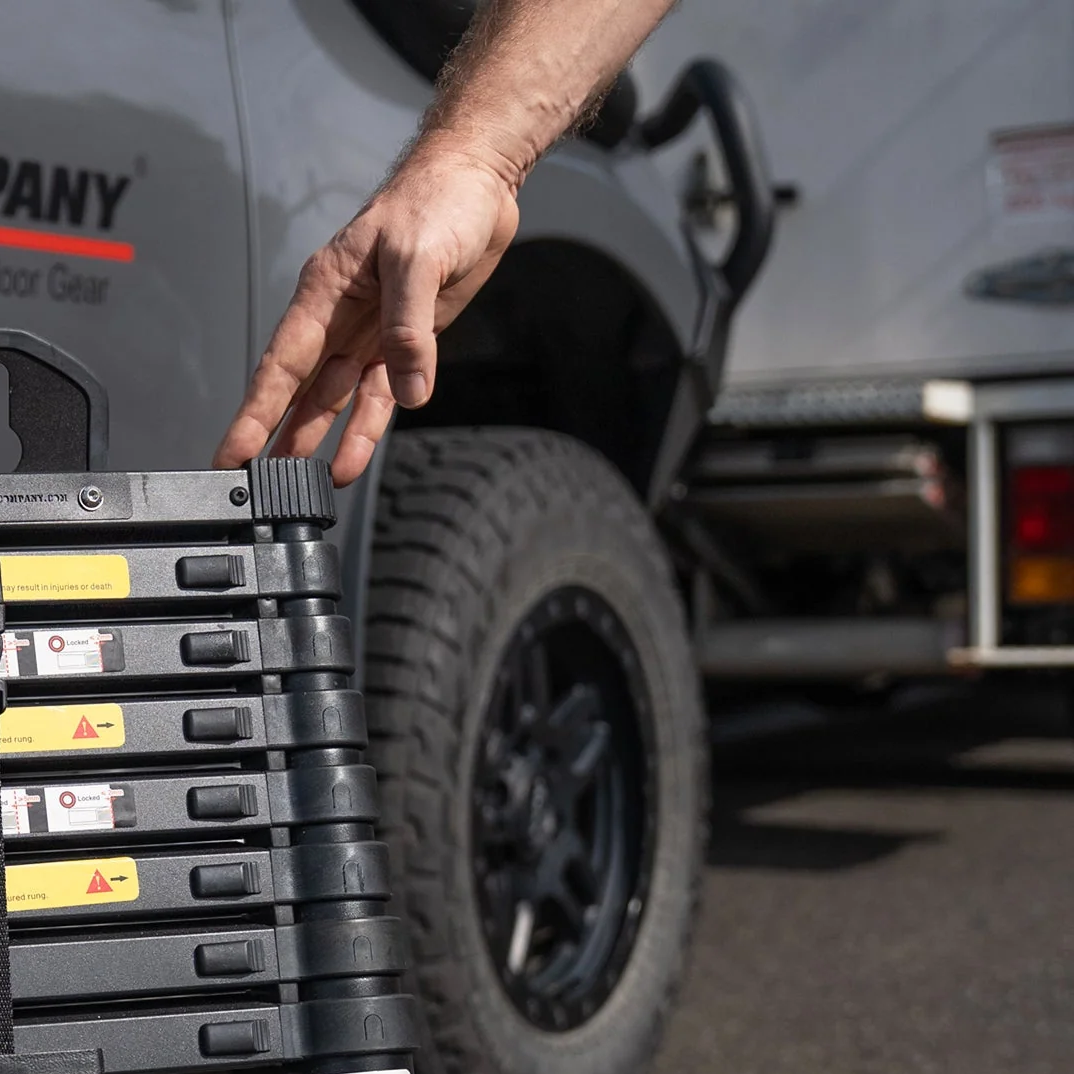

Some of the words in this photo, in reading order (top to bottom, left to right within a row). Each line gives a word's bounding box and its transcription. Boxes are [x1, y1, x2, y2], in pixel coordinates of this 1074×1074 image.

[47, 264, 110, 305] Gear
[17, 583, 39, 591] result
[41, 583, 48, 591] in
[50, 583, 79, 592] injuries
[90, 582, 113, 590] death
[14, 736, 35, 744] rung.
